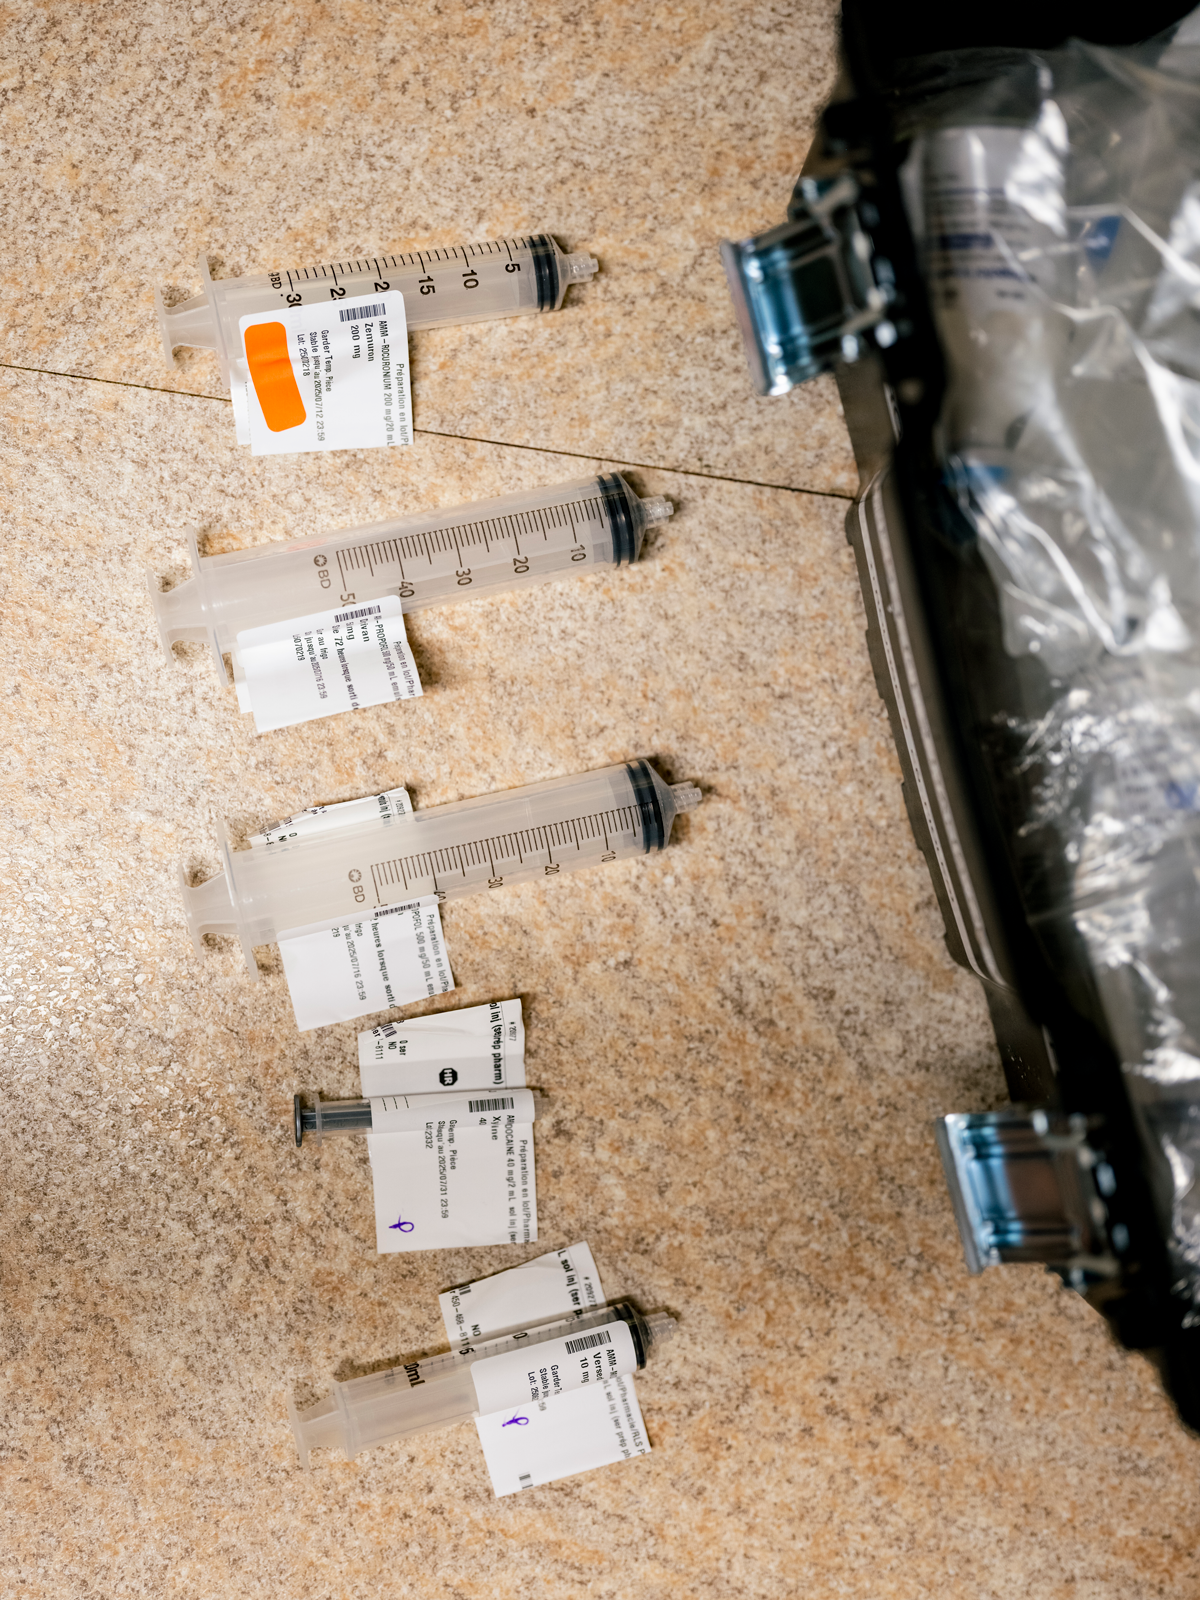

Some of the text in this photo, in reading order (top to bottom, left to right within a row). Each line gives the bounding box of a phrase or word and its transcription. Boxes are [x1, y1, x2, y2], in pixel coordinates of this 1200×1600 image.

[505, 262, 521, 273] 5
[418, 275, 436, 296] 15
[462, 269, 479, 289] 10
[297, 334, 306, 346] Lot:
[321, 330, 331, 353] Garder
[351, 325, 362, 359] 200 mg
[365, 322, 375, 362] Zemuron
[309, 332, 320, 353] Stable
[316, 421, 325, 441] 23:59
[395, 364, 406, 409] Préparation
[384, 393, 393, 406] 200
[384, 409, 394, 432] mg/20
[399, 412, 407, 422] en
[387, 434, 395, 446] mL
[570, 544, 587, 562] 10
[512, 556, 530, 574] 20
[318, 568, 331, 589] BD
[456, 568, 473, 586] 30
[398, 580, 416, 599] 40
[318, 636, 325, 646] au
[334, 636, 344, 646] 72
[346, 684, 357, 700] sorti
[388, 671, 398, 681] mL
[602, 850, 616, 862] 10
[544, 863, 560, 876] 20
[488, 876, 503, 889] 30
[352, 886, 366, 903] BD
[354, 923, 363, 937] frigo
[371, 923, 382, 948] heures
[415, 932, 426, 944] 500
[426, 914, 441, 956] Préparation
[436, 958, 444, 968] en
[376, 950, 390, 981] lorsque
[418, 946, 431, 969] mg/50
[347, 940, 362, 978] 2025/07/16
[355, 980, 367, 1001] 23:59
[424, 971, 434, 982] mL
[385, 985, 396, 1002] sorti
[490, 1012, 501, 1022] inj
[388, 1041, 397, 1050] NO
[399, 1046, 407, 1056] ser
[444, 1069, 453, 1085] HR
[491, 1053, 504, 1085] pharm)
[449, 1150, 458, 1170] Pièce
[506, 1158, 515, 1167] 40
[438, 1156, 448, 1196] 2025/07/31
[506, 1170, 516, 1188] mg/2
[508, 1190, 516, 1202] mL
[518, 1140, 531, 1243] Préparation en lot/Pharma
[441, 1199, 449, 1219] 23:59
[509, 1207, 517, 1216] sol
[508, 1219, 517, 1228] inj
[561, 1259, 574, 1273] sol
[566, 1275, 577, 1287] inj
[568, 1289, 582, 1306] (ser
[471, 1324, 481, 1336] NO
[579, 1357, 590, 1383] 10 mg
[593, 1352, 605, 1381] Versed
[528, 1371, 538, 1386] Lot:
[539, 1368, 550, 1390] Stable
[550, 1364, 561, 1388] Garder
[605, 1392, 614, 1402] sol
[608, 1404, 618, 1414] inj
[610, 1416, 622, 1429] (ser
[614, 1431, 627, 1448] prép
